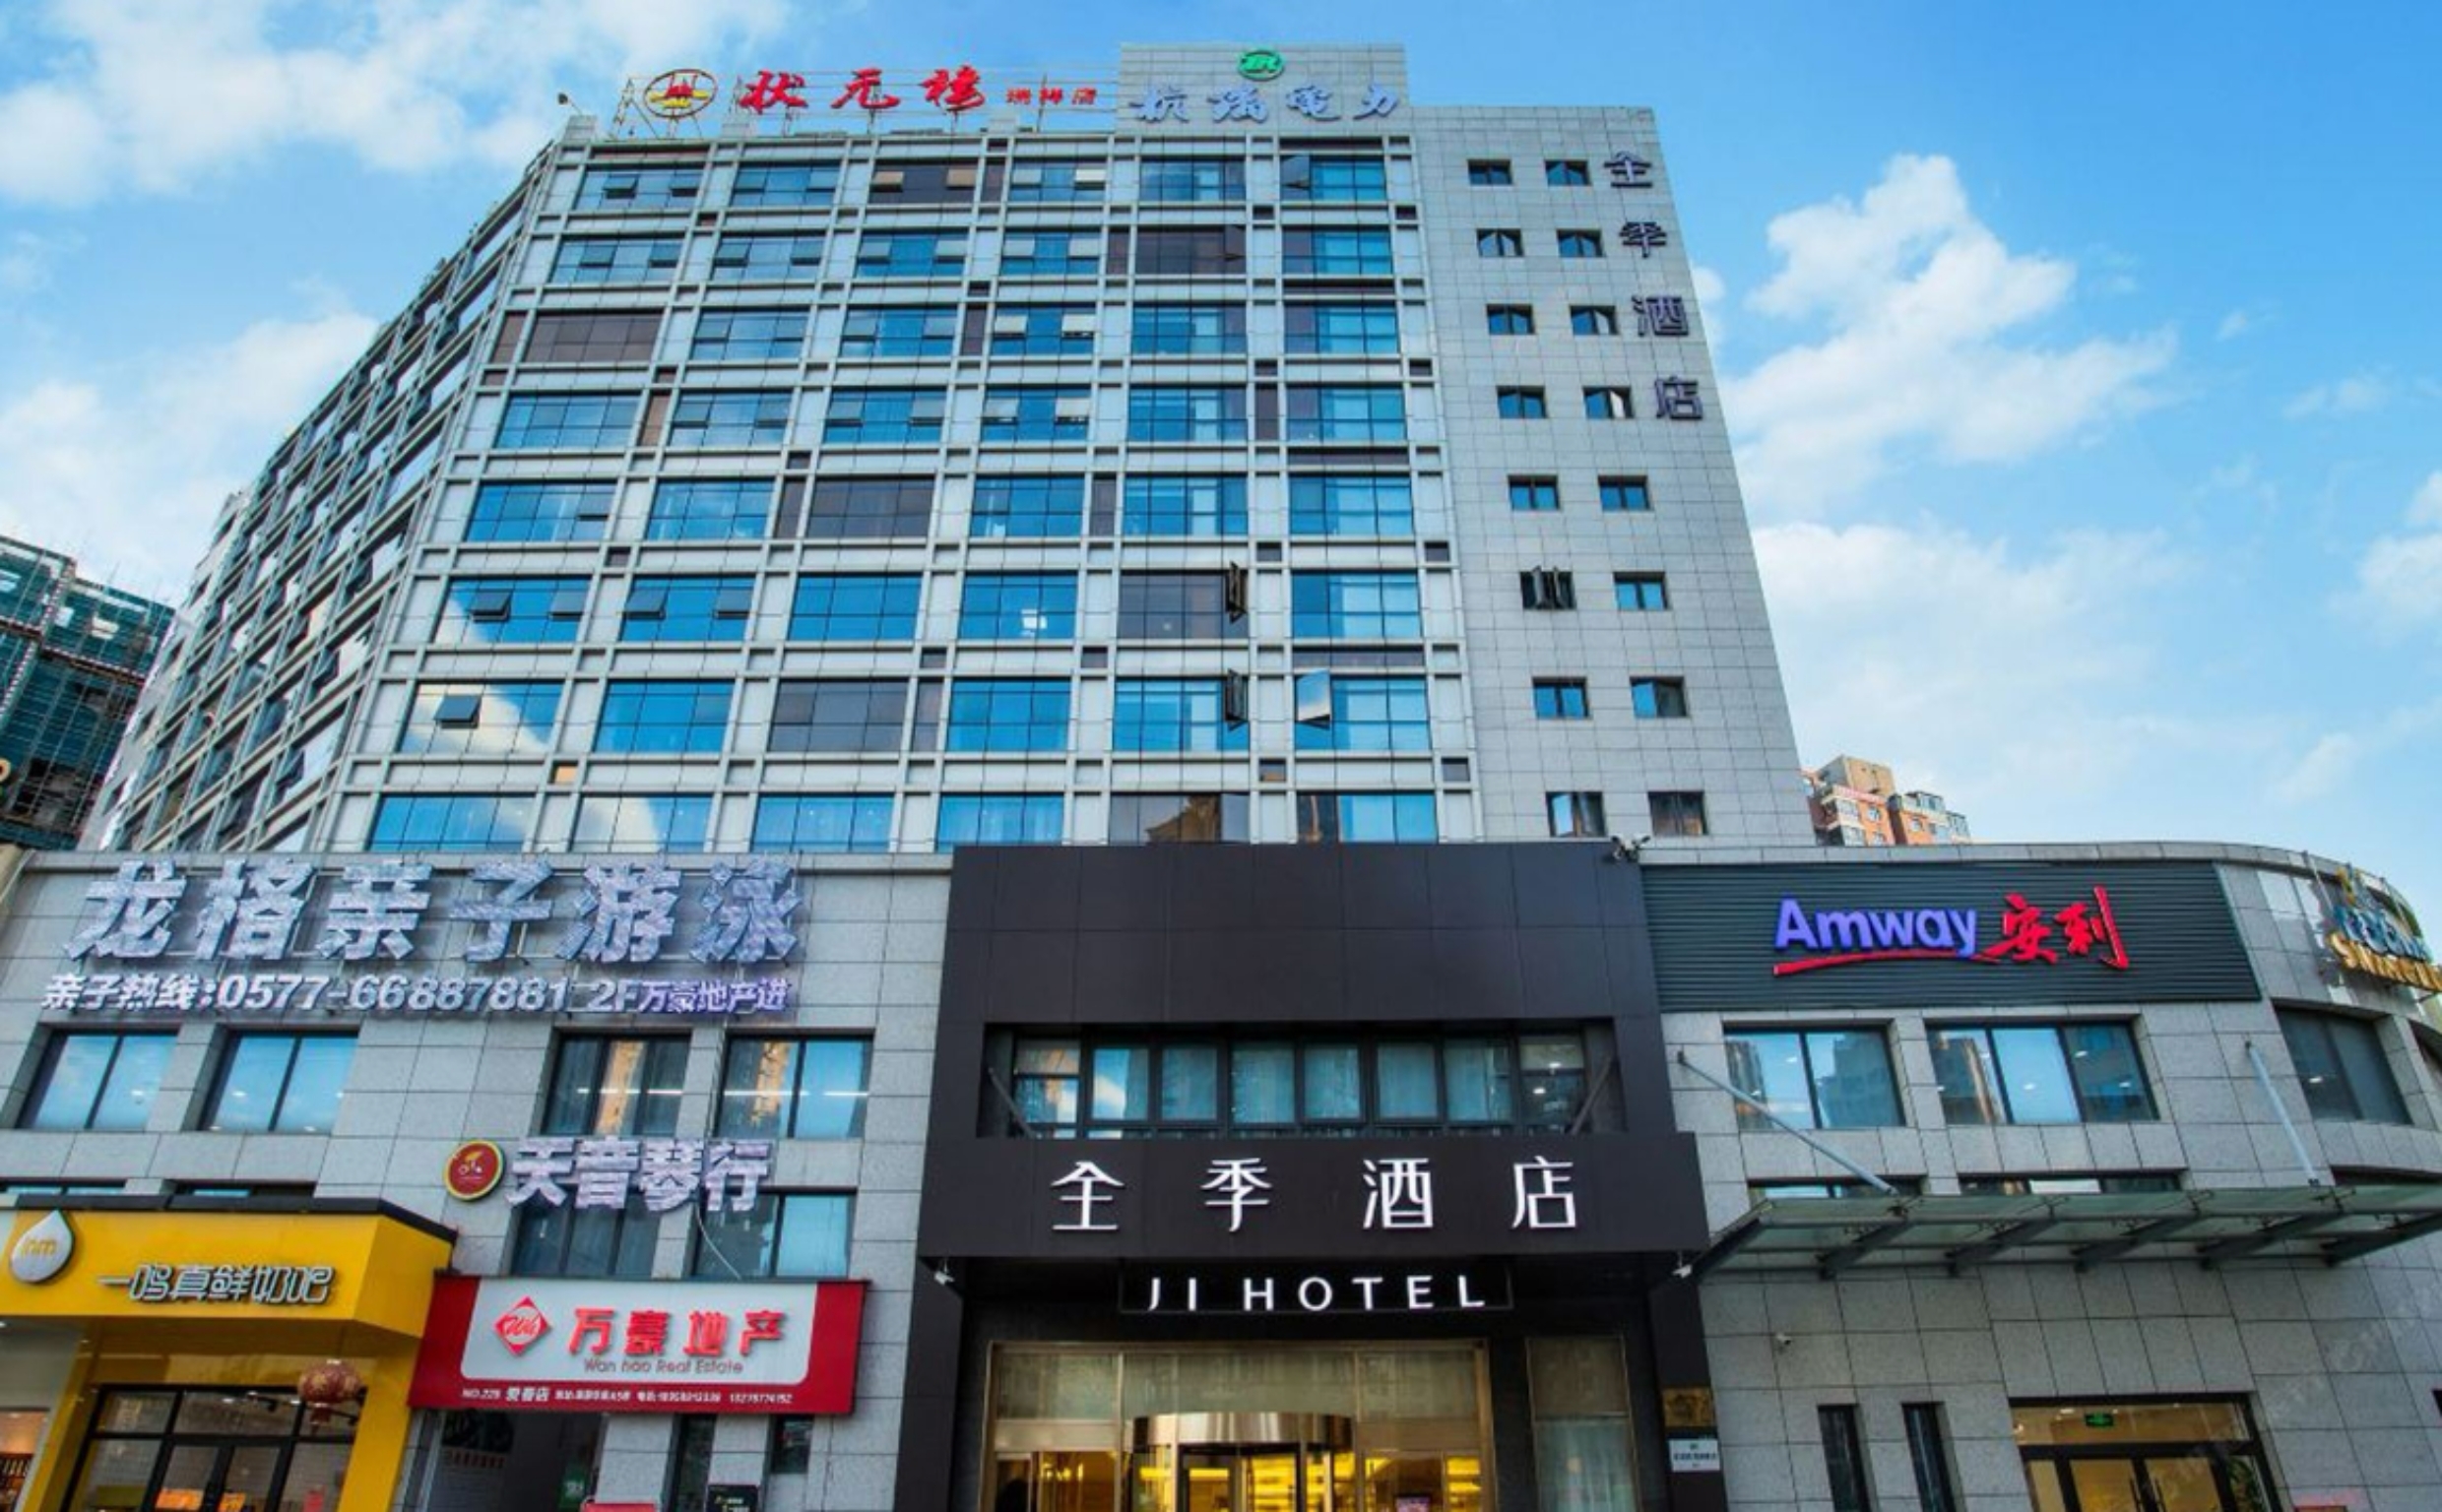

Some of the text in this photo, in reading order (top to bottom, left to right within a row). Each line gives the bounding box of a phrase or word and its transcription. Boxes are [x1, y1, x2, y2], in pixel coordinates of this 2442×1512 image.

[1604, 152, 1703, 420] 全季酒店
[63, 857, 802, 963] 龙格亲子游泳
[1774, 885, 2129, 969] Amway 安利
[504, 1134, 773, 1213] 天音琴行
[1051, 1156, 1576, 1231] 全季酒店
[98, 1264, 333, 1303] 一鸣真鲜奶吧
[1148, 1276, 1486, 1310] JI HOTEL
[567, 1307, 786, 1356] 万豪地产
[585, 1357, 743, 1374] Wan hao Real Estate
